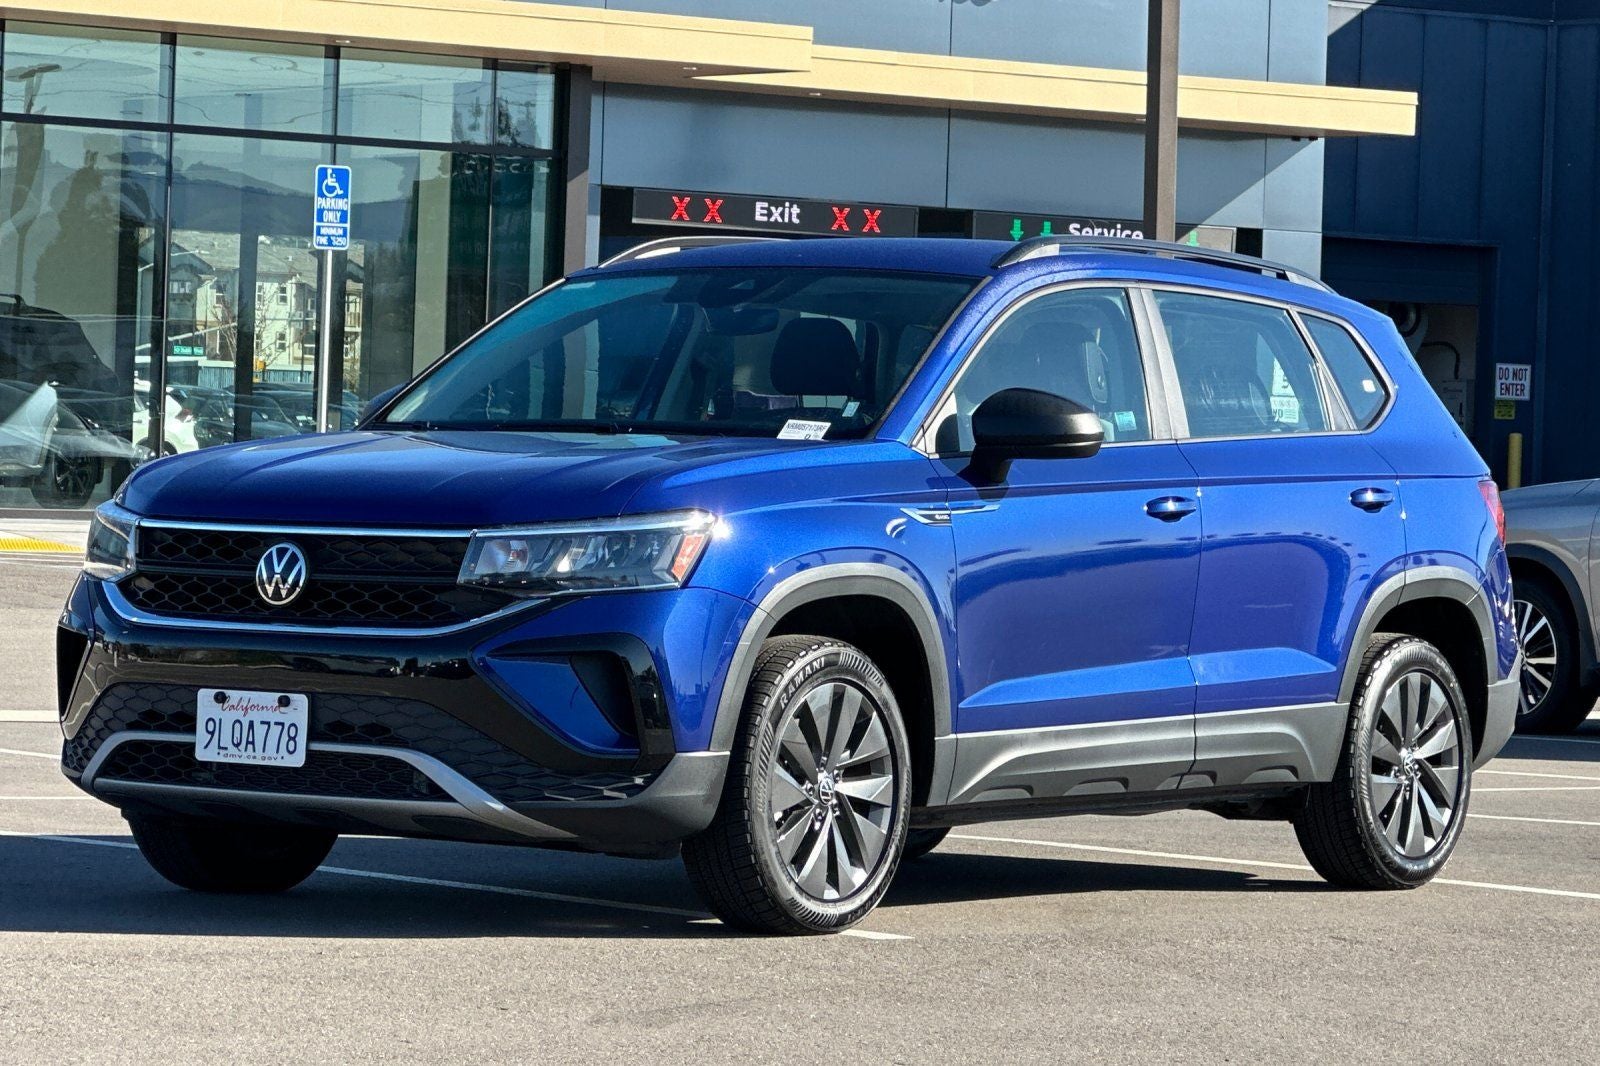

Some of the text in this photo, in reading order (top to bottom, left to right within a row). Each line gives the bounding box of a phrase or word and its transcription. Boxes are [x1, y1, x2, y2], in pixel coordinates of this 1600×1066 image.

[317, 197, 348, 210] PARKING
[323, 210, 342, 223] ONLY
[755, 201, 801, 224] Exit
[1068, 222, 1144, 240] Service
[316, 236, 328, 245] FINE
[1498, 367, 1528, 382] DO NOT
[1500, 383, 1526, 397] ENTER
[221, 695, 288, 717] California
[203, 717, 298, 755] 9LQA778
